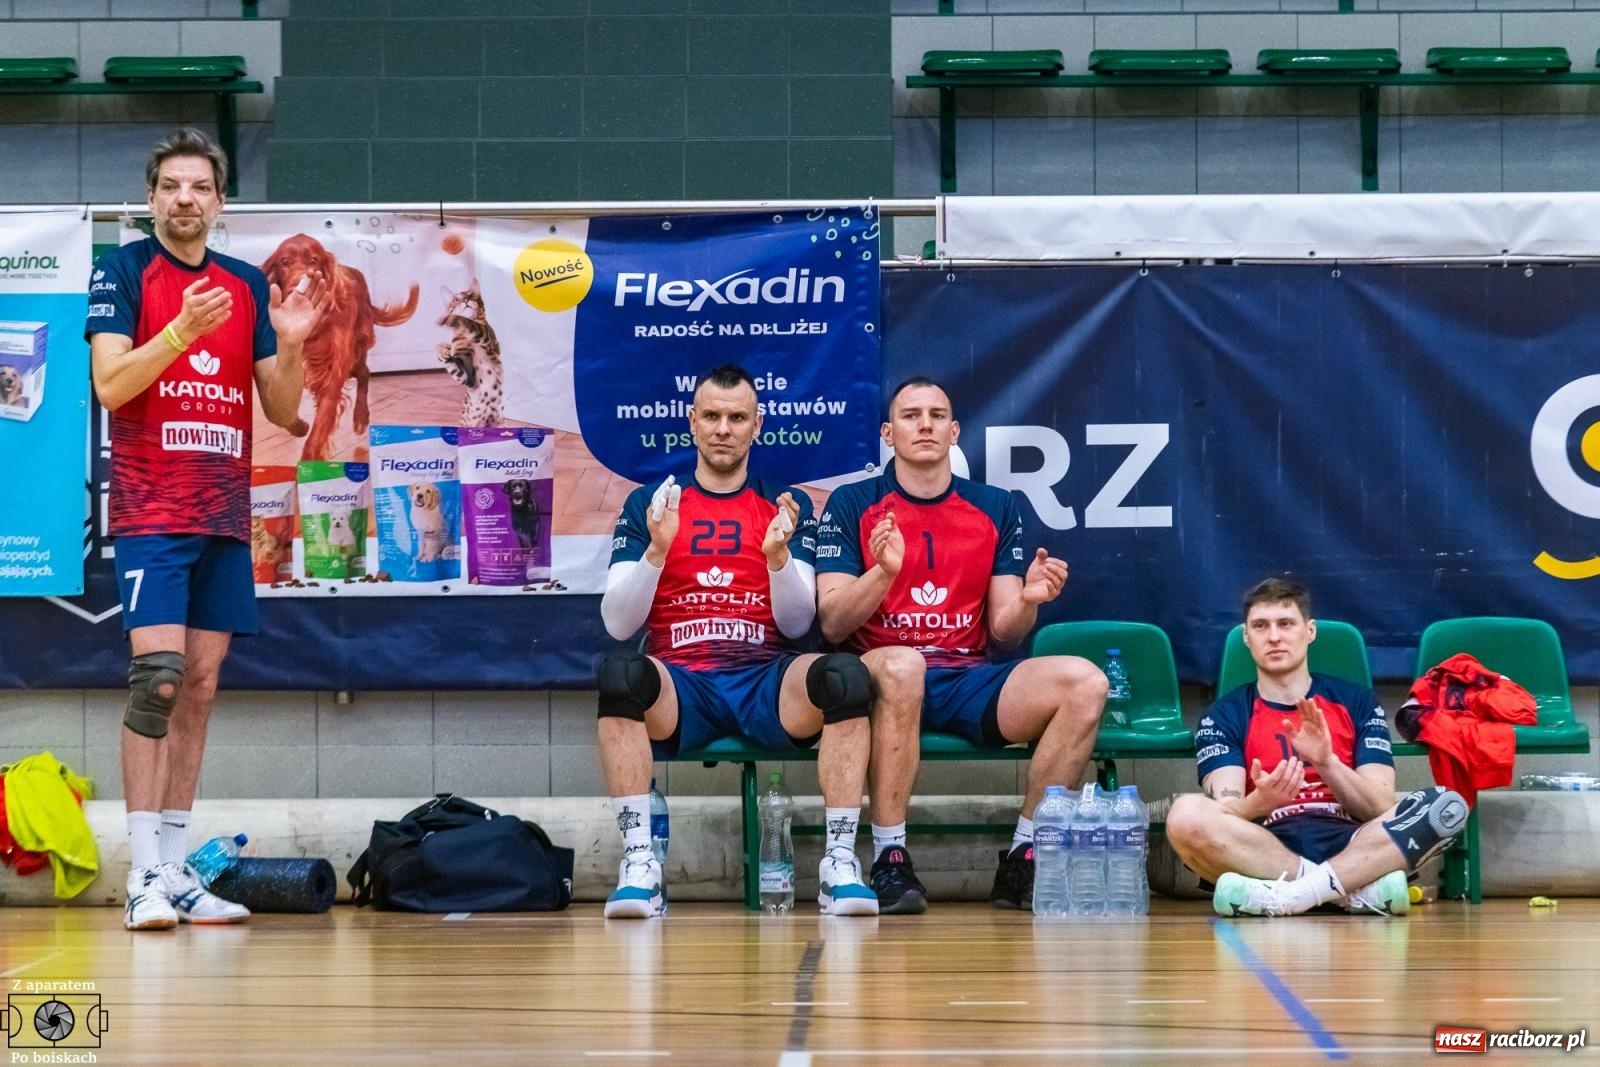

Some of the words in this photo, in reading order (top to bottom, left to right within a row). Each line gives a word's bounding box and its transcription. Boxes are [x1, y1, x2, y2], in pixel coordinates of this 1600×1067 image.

[520, 259, 584, 284] Nowość
[614, 267, 845, 311] Flexadin
[634, 320, 714, 337] RADOŚĆ
[718, 323, 745, 336] NA
[750, 318, 827, 335] DŁUŻEJ
[159, 380, 245, 405] KATOLIK
[164, 423, 240, 456] nowiny.pl
[641, 433, 656, 448] u
[381, 458, 455, 472] Flexadin
[475, 458, 539, 470] Flexadin
[251, 500, 285, 510] xadin
[311, 493, 358, 503] Flexadin
[690, 519, 742, 555] 23
[922, 530, 934, 570] 1
[125, 568, 144, 612] 7
[673, 618, 762, 643] nowiny.pl
[881, 612, 973, 629] KATOLIK
